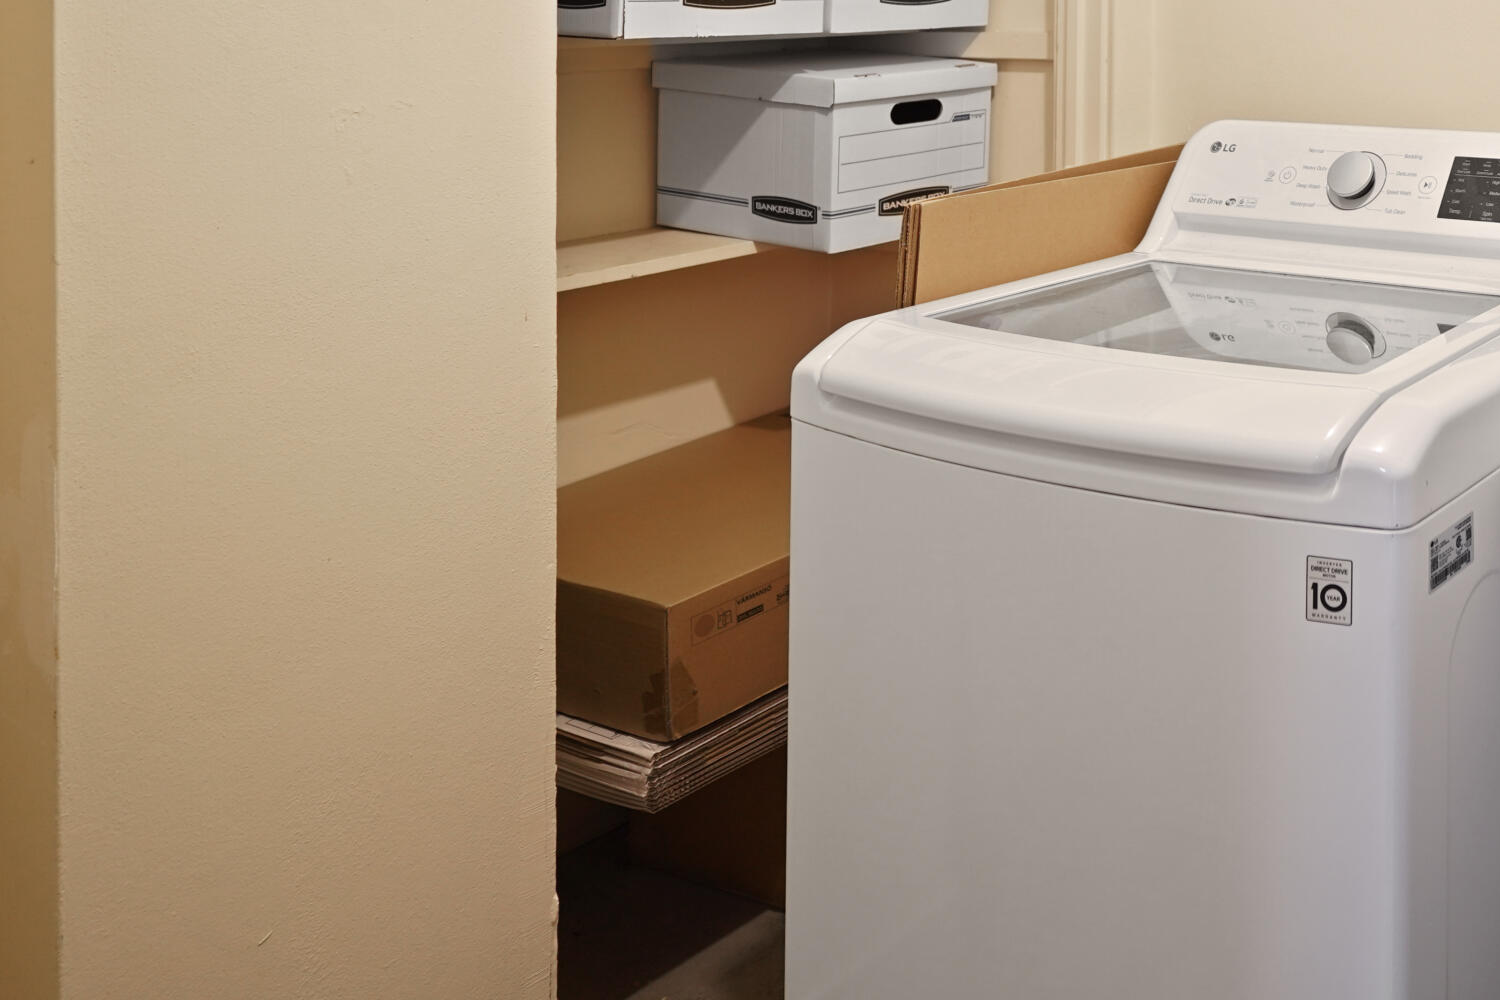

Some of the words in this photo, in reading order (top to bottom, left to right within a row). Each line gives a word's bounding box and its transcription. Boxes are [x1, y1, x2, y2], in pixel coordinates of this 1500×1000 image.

[755, 201, 795, 215] BANKERS
[795, 208, 814, 218] BOX
[1310, 565, 1330, 573] DIRECT
[1330, 568, 1348, 576] DRIVE
[1311, 582, 1348, 612] 10
[1311, 612, 1347, 621] WARRANTY
